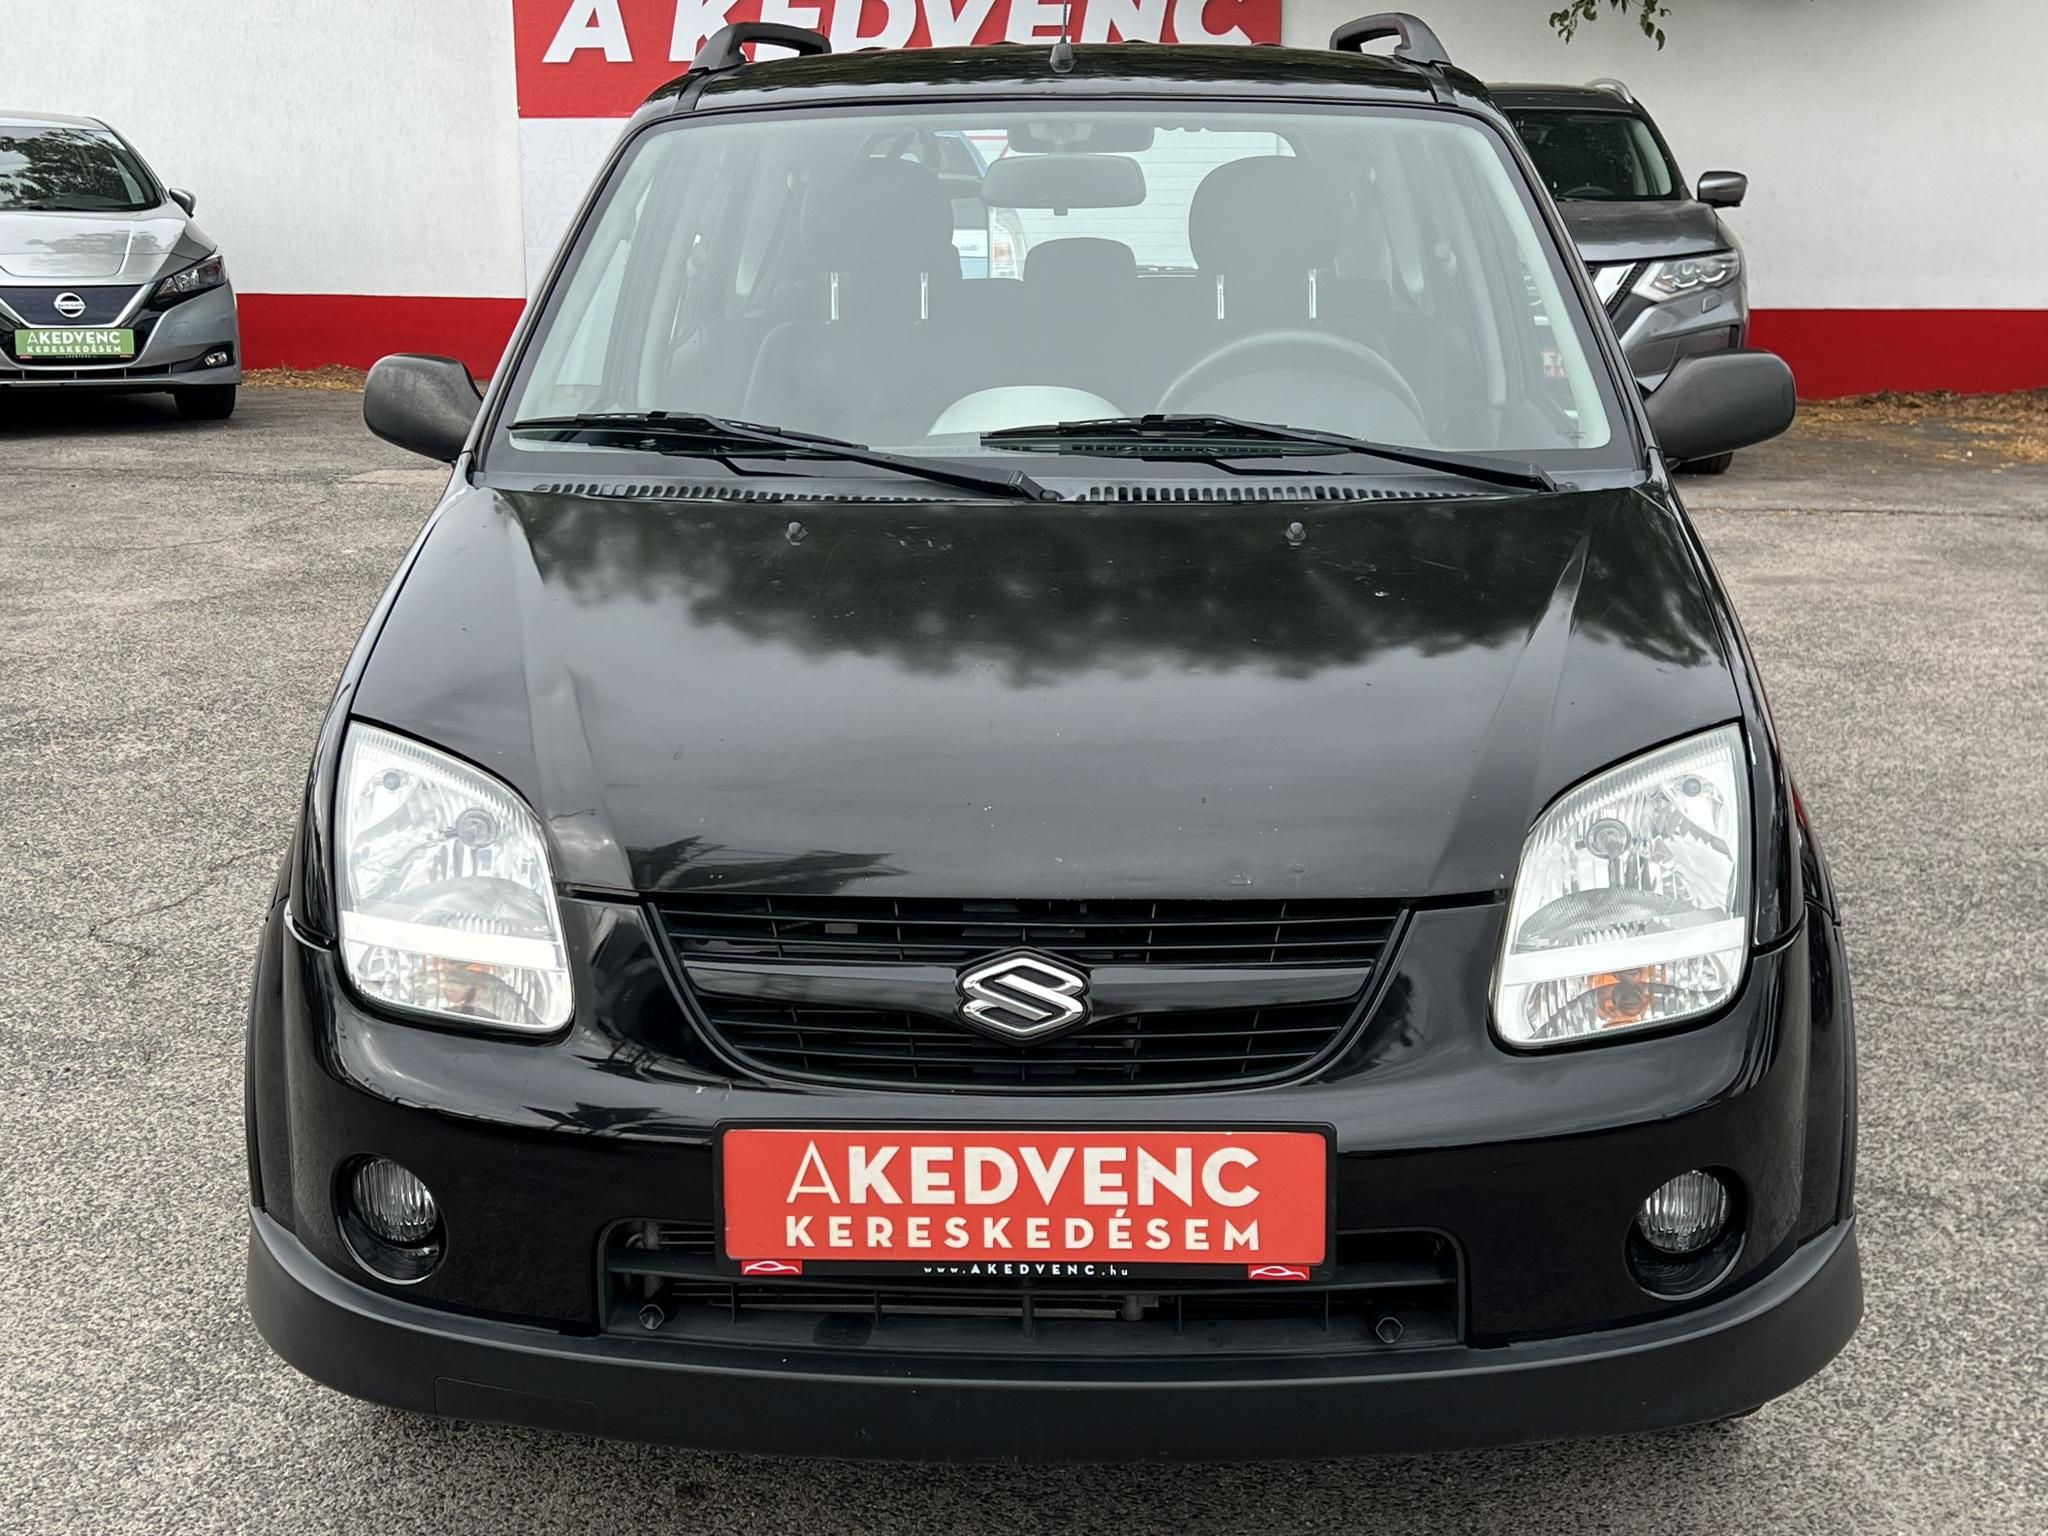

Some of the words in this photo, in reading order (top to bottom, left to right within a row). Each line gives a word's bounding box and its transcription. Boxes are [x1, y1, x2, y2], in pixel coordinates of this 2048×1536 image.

[541, 0, 633, 62] A
[786, 1209, 1260, 1251] KERESKEDÉSEM
[923, 1263, 1129, 1277] www.AKEDVENC.hu
